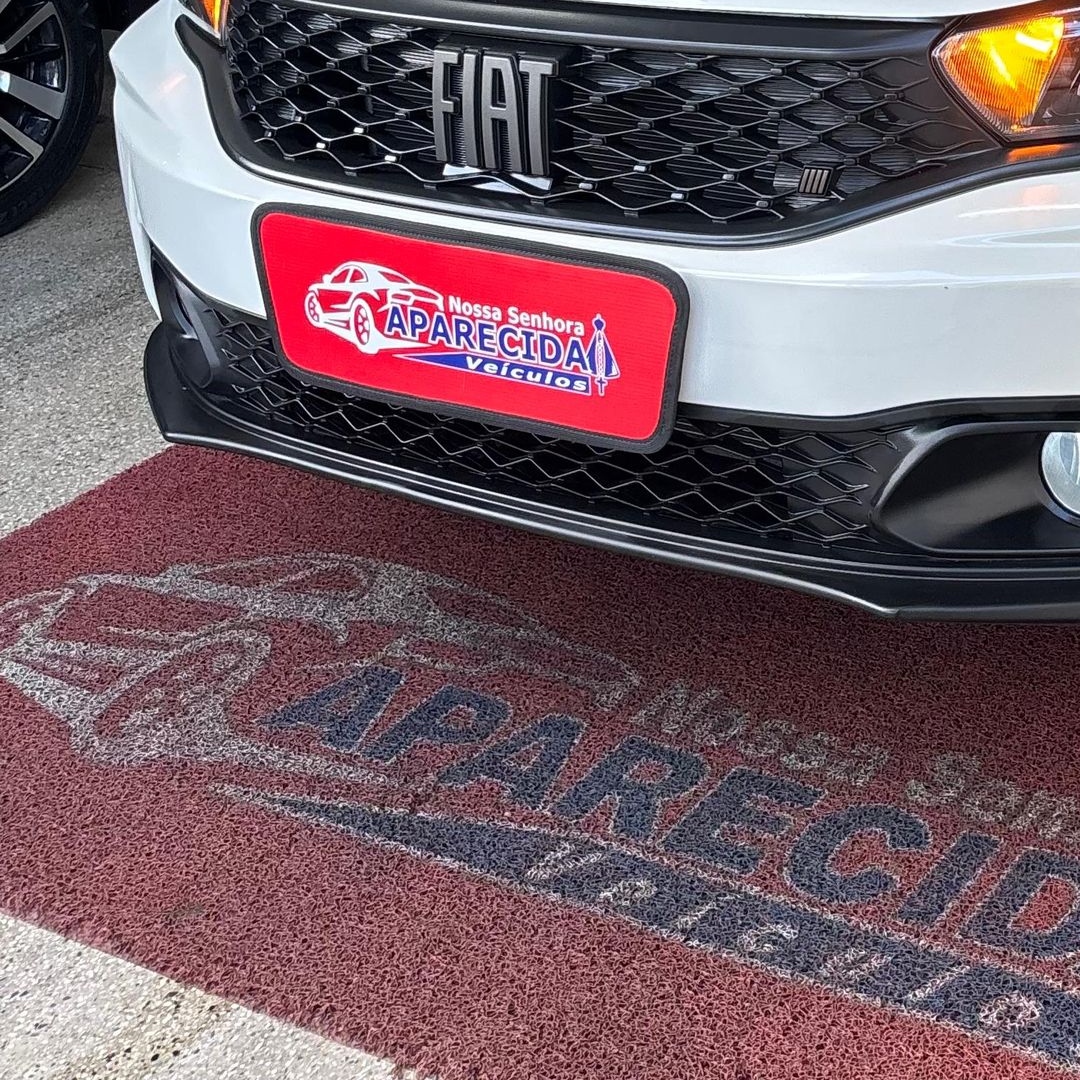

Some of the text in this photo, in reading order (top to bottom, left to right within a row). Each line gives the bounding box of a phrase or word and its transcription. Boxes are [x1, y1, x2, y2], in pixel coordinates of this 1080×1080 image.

[431, 49, 561, 177] FIAT
[386, 306, 590, 373] APARECIDA
[448, 294, 585, 336] Nossa Senhora
[465, 354, 588, 392] Veículos
[633, 678, 890, 788] Nossa
